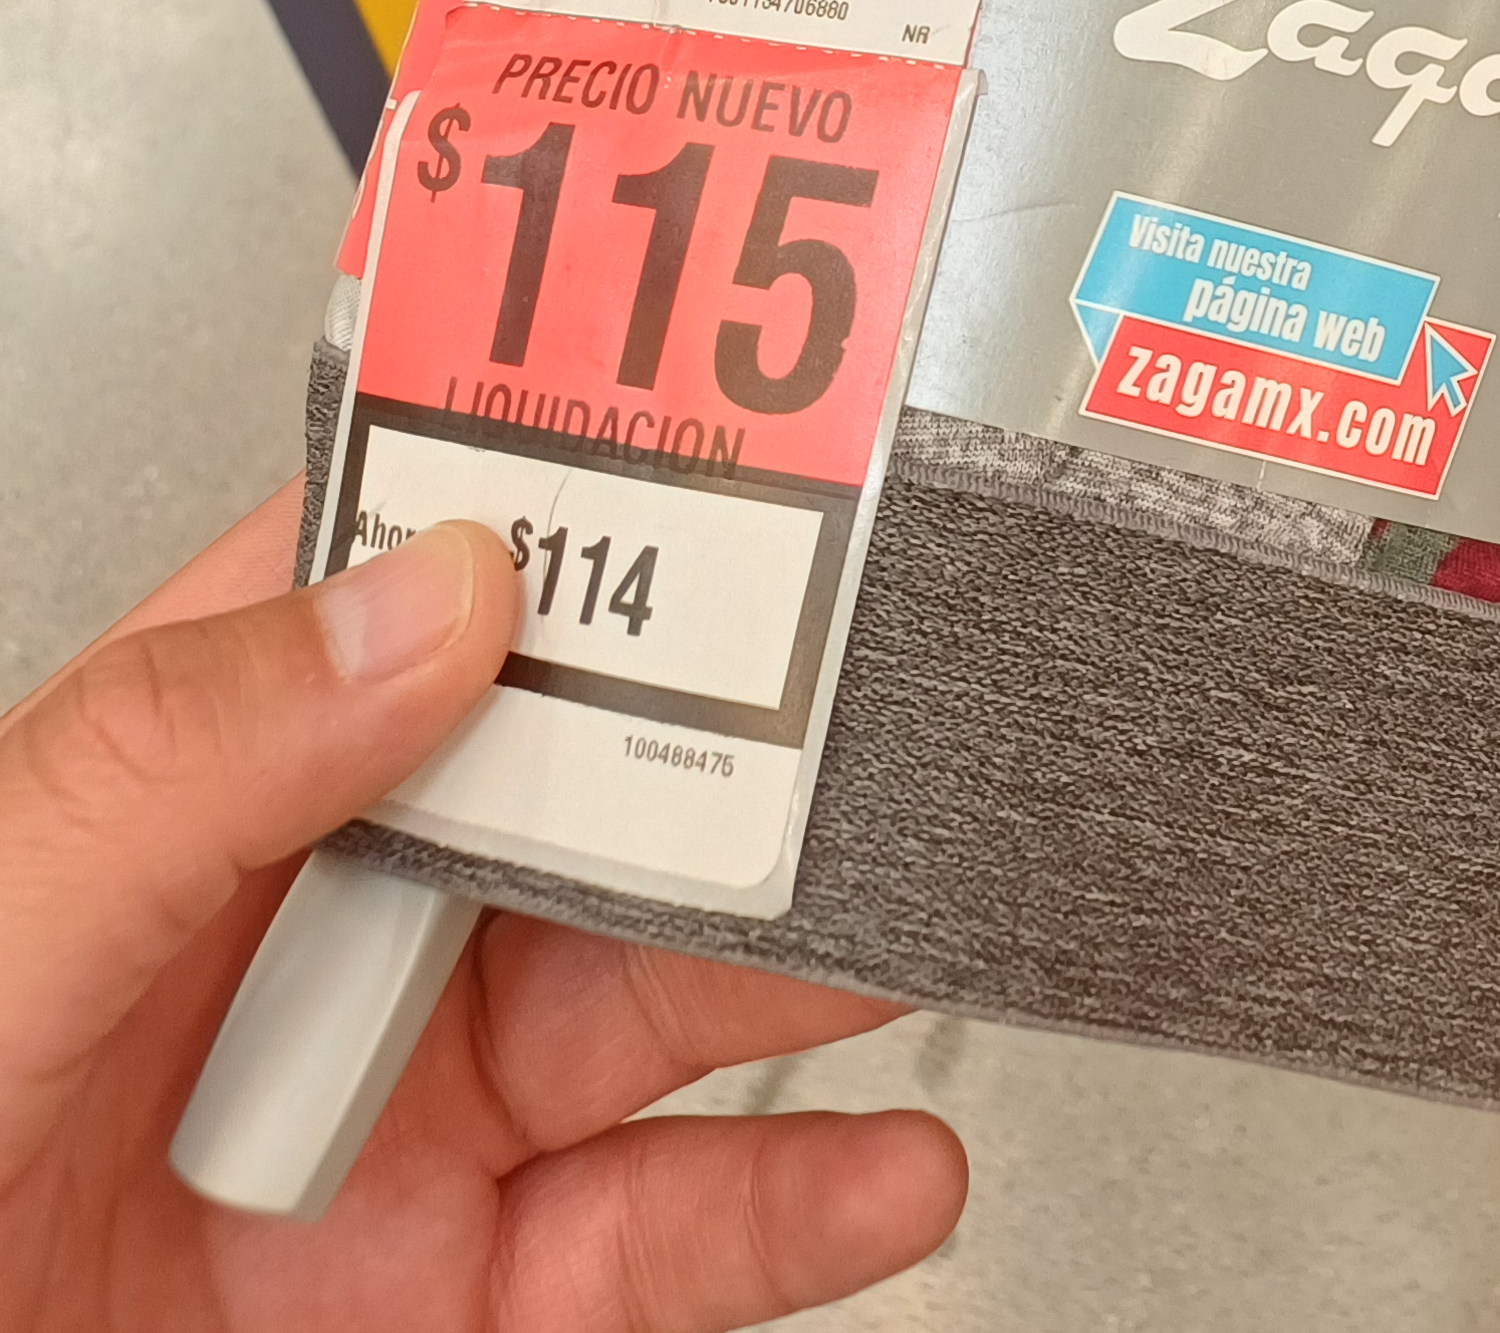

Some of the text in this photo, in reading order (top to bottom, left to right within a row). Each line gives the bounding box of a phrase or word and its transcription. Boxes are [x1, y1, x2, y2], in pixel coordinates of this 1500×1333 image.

[901, 23, 931, 45] NR
[491, 53, 855, 145] PRECIO NUEVO
[416, 102, 881, 417] $115
[1128, 213, 1313, 292] Visita nuestra
[1181, 275, 1387, 363] página web
[441, 375, 747, 481] LIQUIDACION
[1115, 345, 1437, 467] zagamx.com
[508, 515, 660, 637] $114
